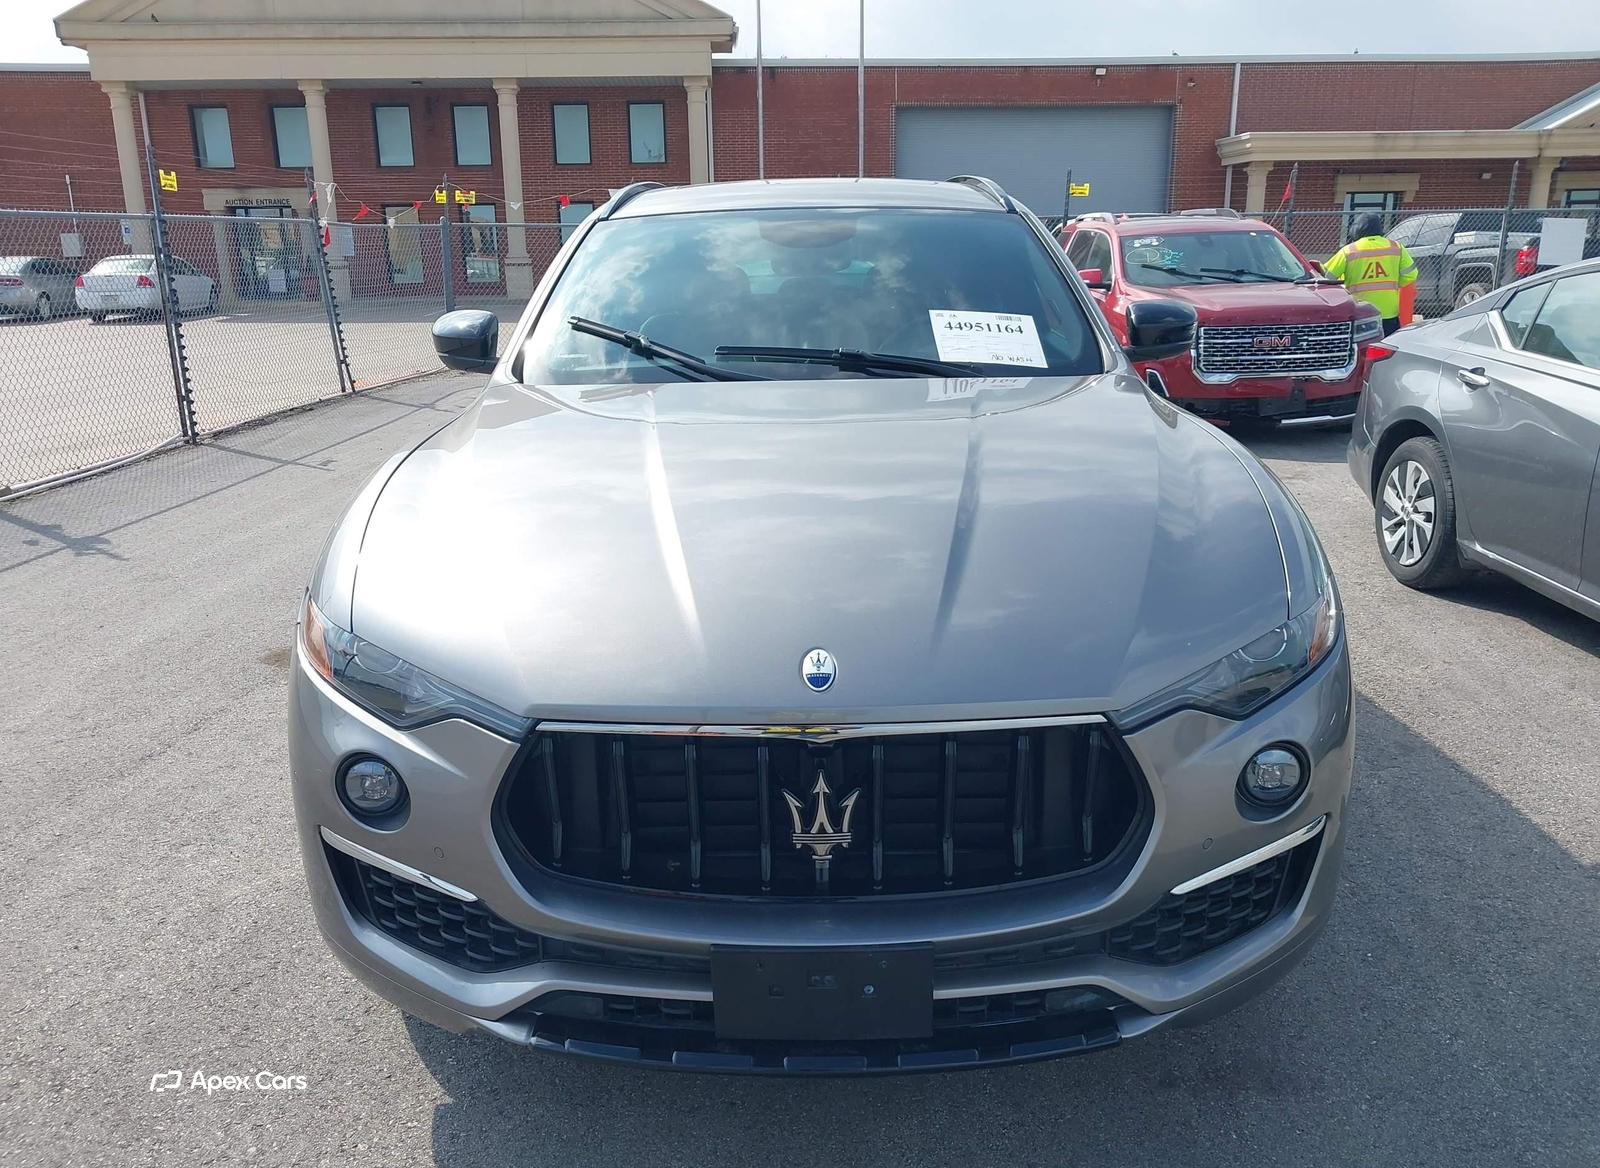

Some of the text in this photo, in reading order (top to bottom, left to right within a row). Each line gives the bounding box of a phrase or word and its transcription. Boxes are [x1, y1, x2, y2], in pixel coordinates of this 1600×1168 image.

[256, 198, 291, 206] ENTRANCE
[944, 321, 1024, 335] 44951164
[991, 354, 1004, 362] NO
